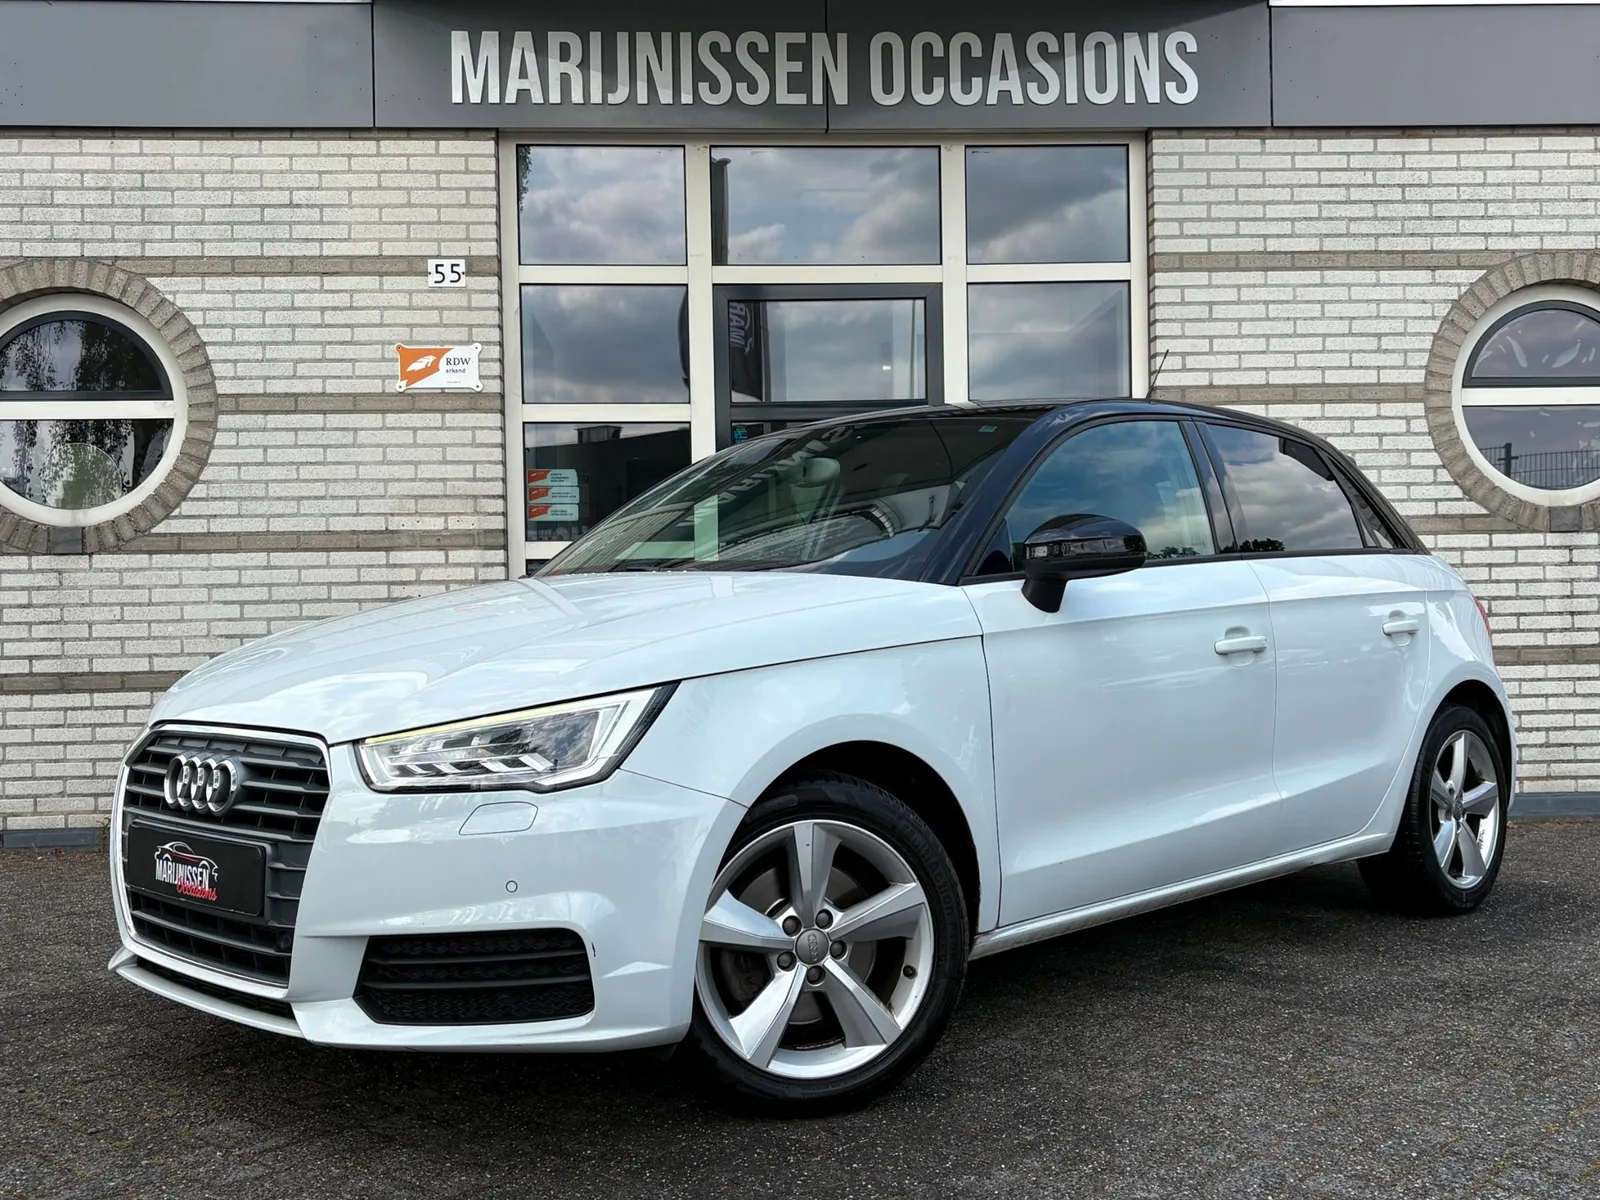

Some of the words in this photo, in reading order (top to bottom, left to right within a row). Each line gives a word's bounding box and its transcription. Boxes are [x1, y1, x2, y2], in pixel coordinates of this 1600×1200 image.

[450, 30, 849, 106] MARIJNISSEN
[869, 30, 1199, 107] OCCASIONS
[433, 263, 462, 284] 55
[445, 357, 471, 366] RDW
[155, 858, 210, 892] MARIJNISSEN
[176, 876, 218, 902] Occasions
